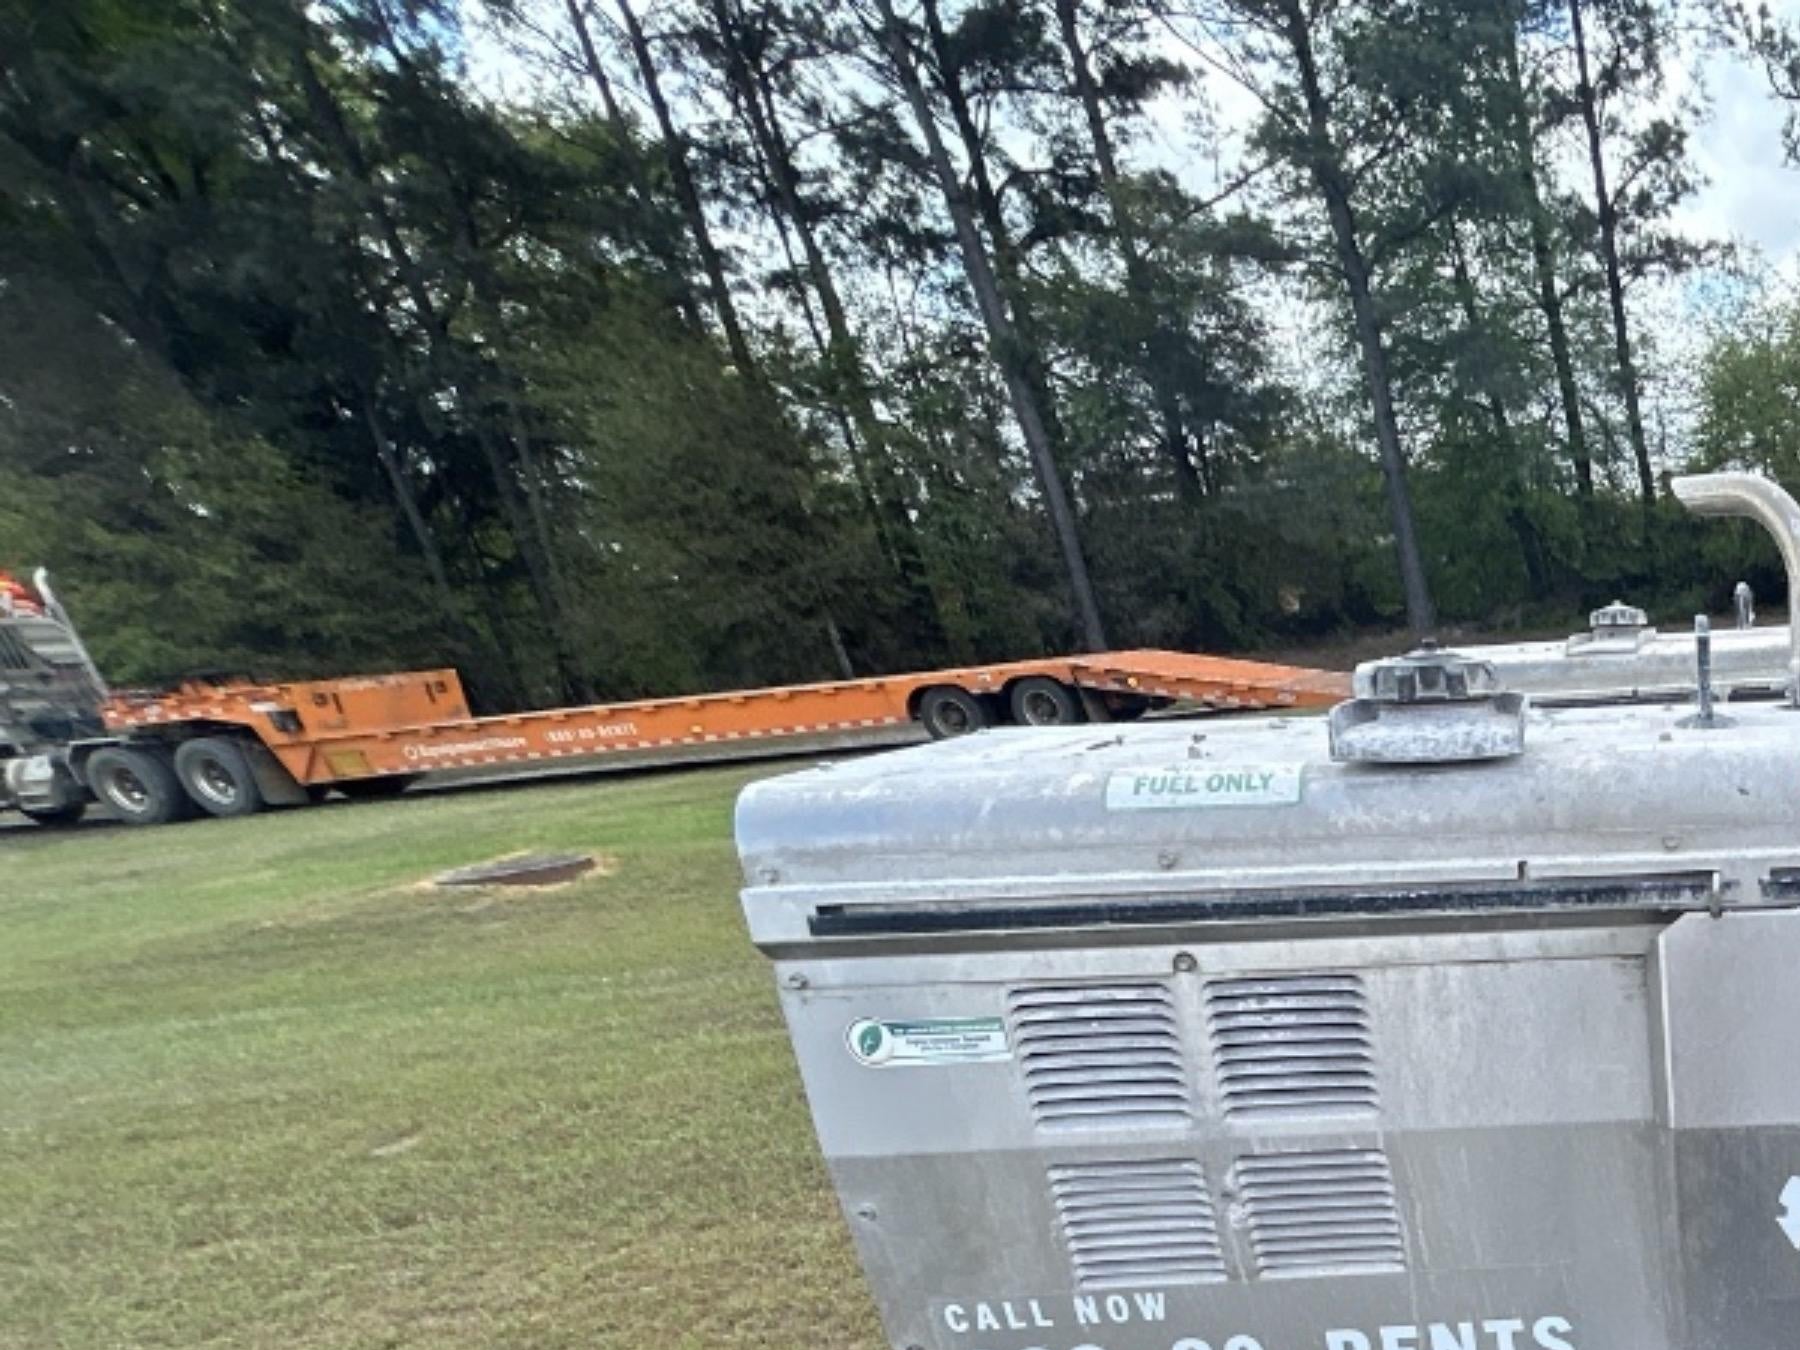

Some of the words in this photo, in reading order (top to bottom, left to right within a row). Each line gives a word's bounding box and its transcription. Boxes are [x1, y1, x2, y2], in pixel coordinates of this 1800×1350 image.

[1132, 775, 1199, 796] FUEL
[1204, 772, 1274, 793] ONLY
[943, 1298, 1055, 1333] CALL
[1071, 1291, 1167, 1326] NOW
